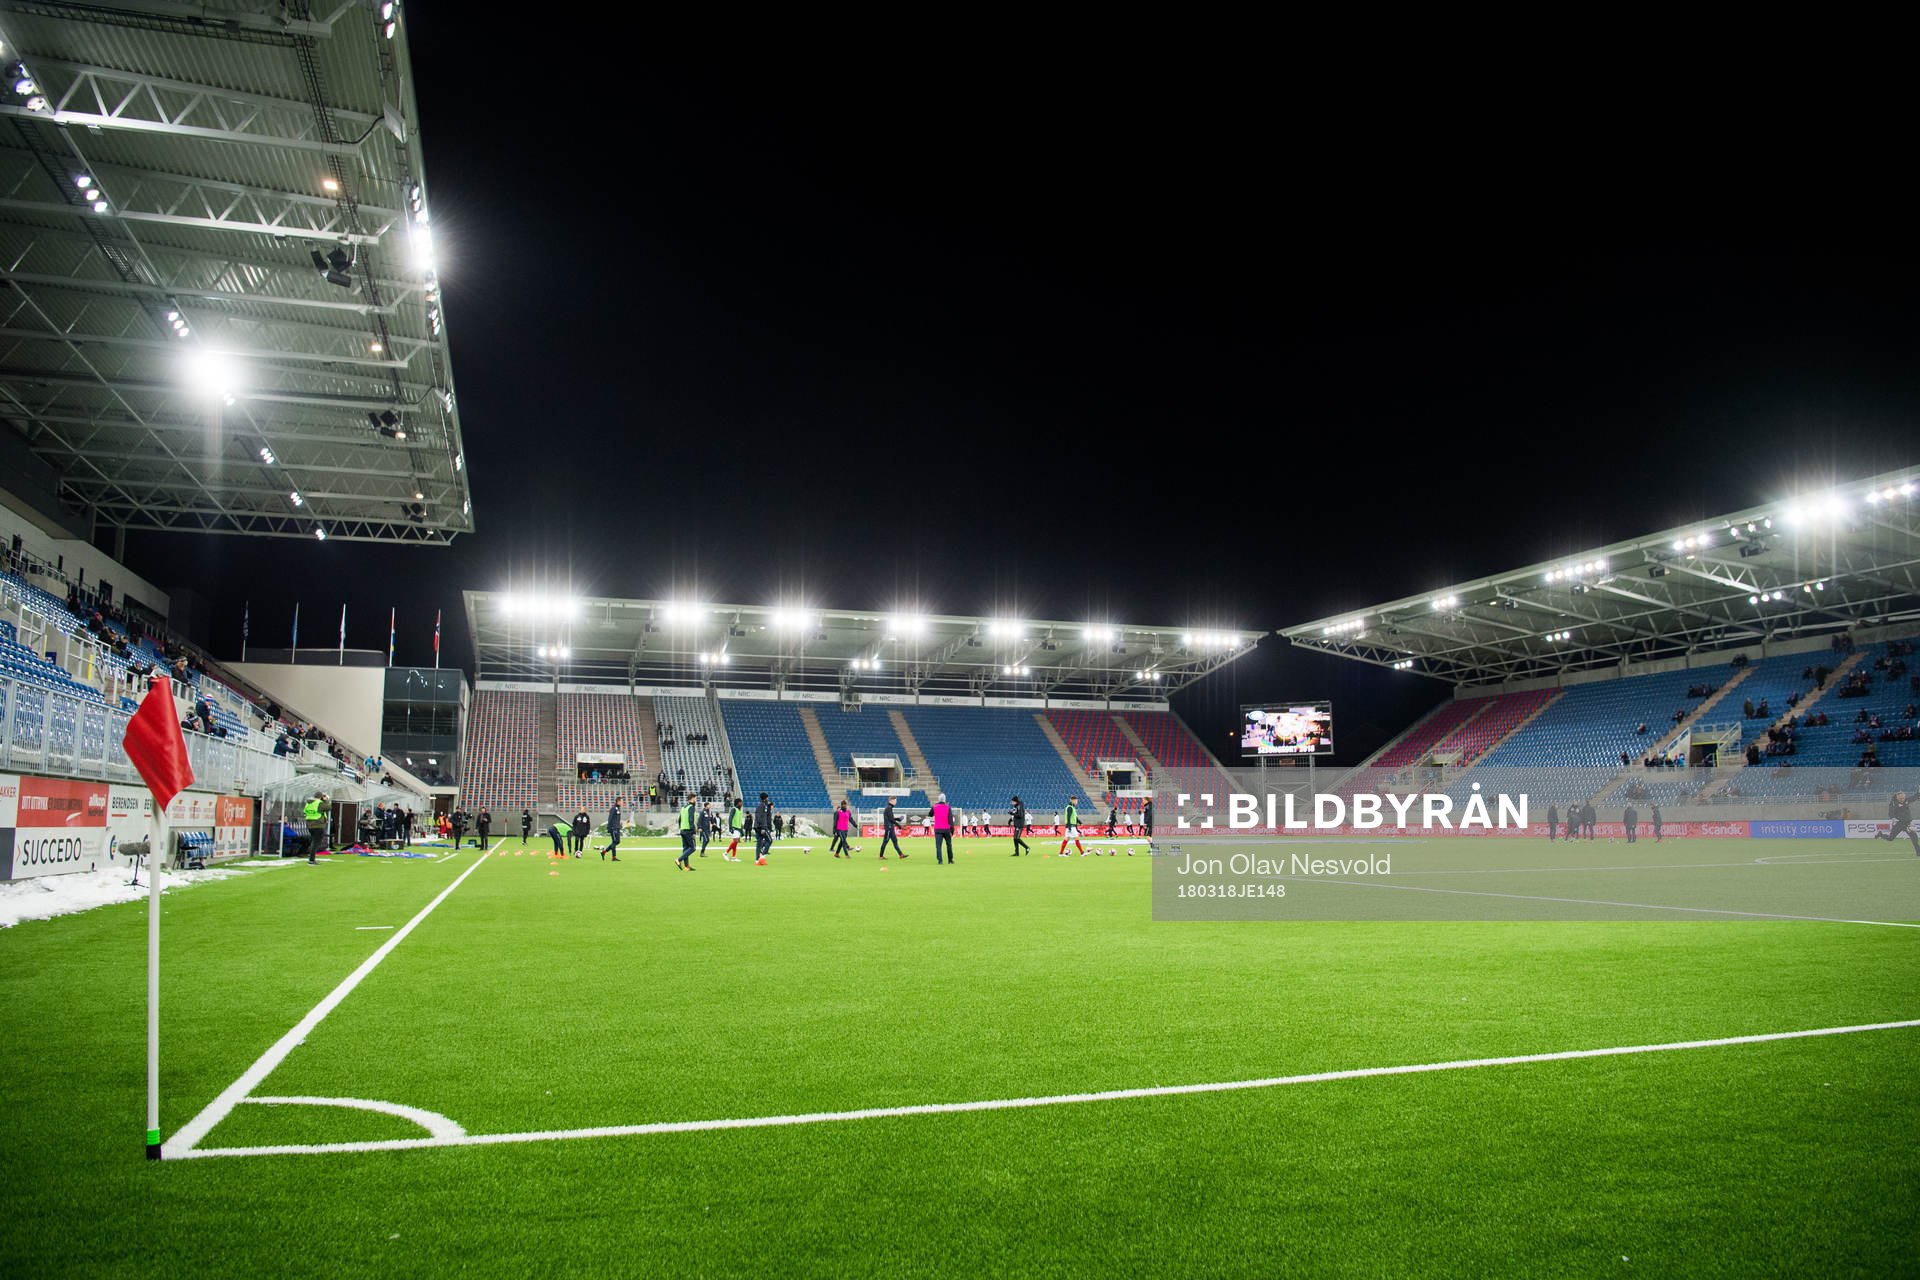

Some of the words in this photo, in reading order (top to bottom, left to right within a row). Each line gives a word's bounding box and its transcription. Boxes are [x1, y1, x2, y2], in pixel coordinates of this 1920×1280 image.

[112, 796, 138, 810] BERENDSEN
[1701, 823, 1743, 836] Scandic
[1761, 824, 1797, 836] intility
[1800, 825, 1833, 834] arena
[1848, 823, 1876, 833] PSS
[22, 837, 82, 866] SUCCEDO
